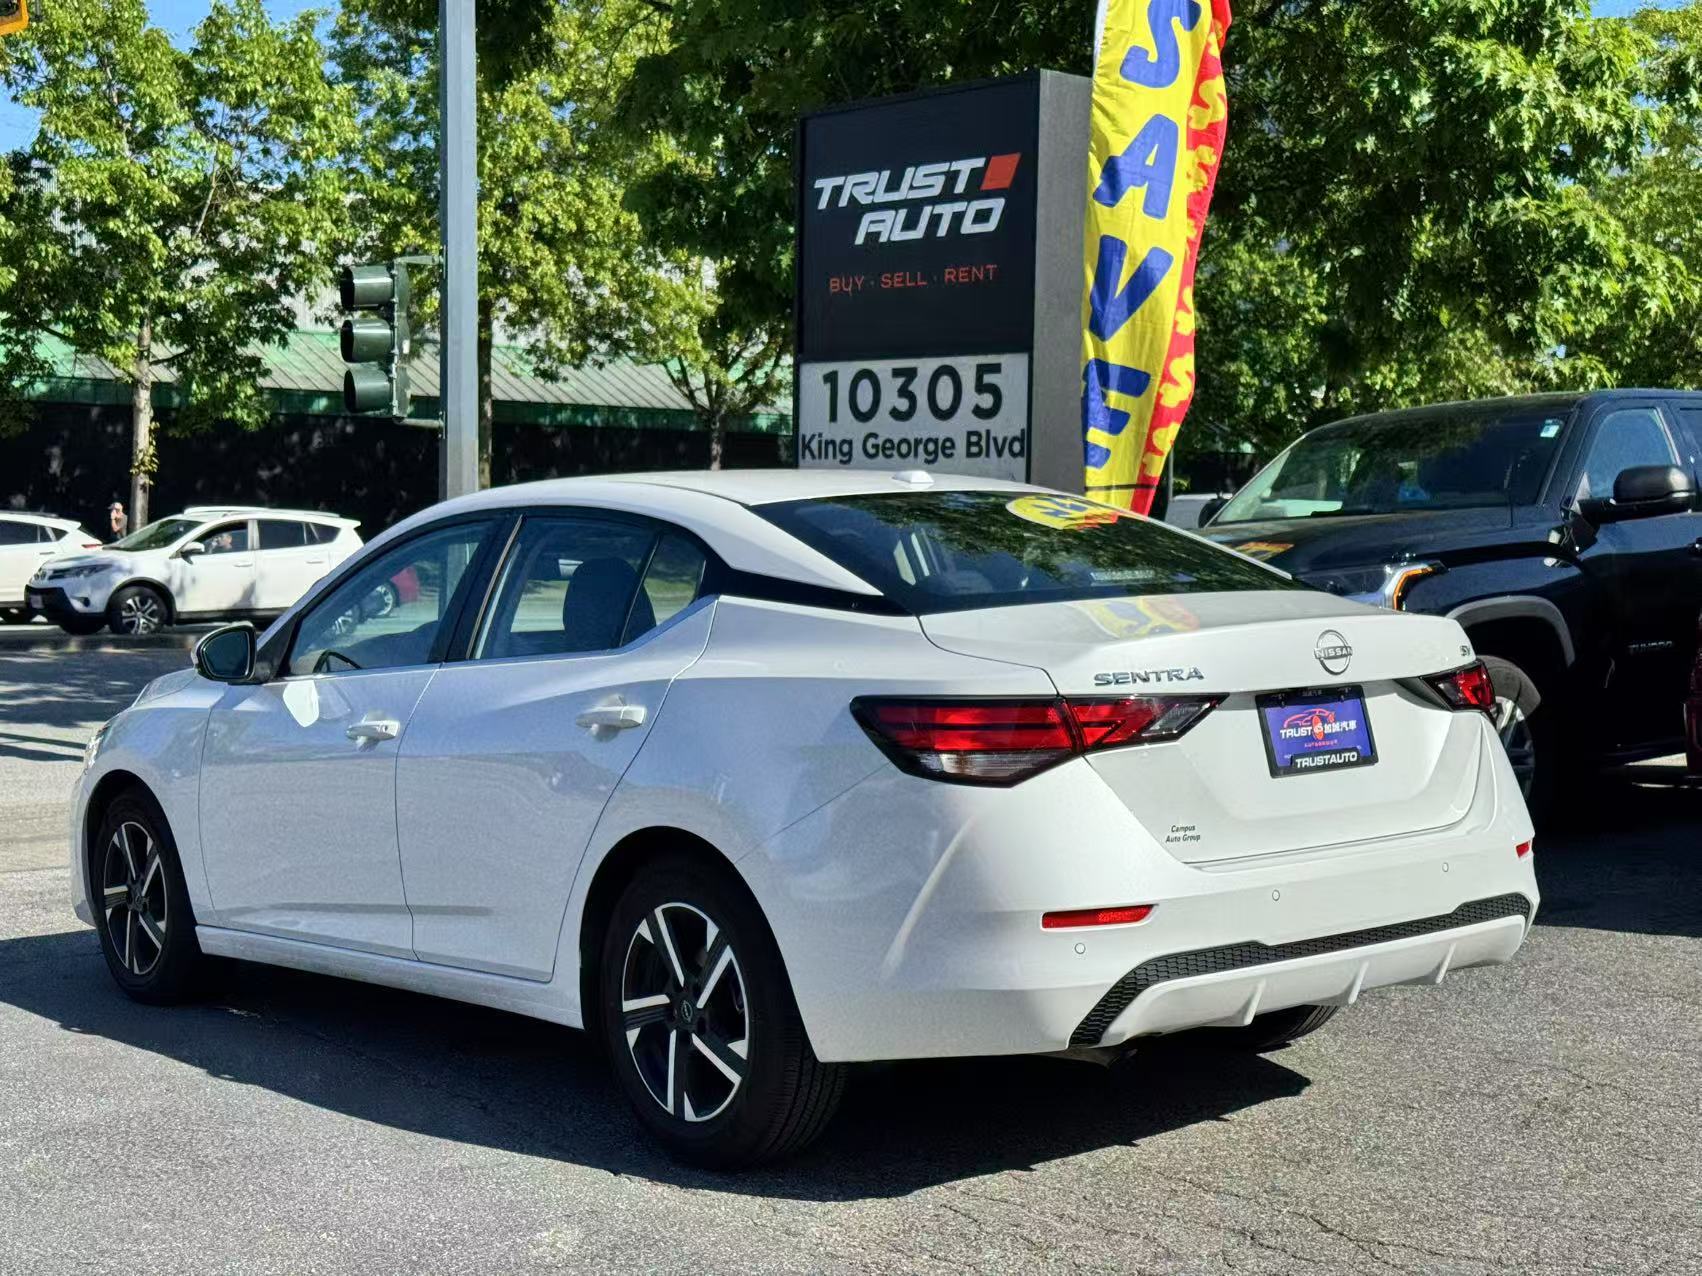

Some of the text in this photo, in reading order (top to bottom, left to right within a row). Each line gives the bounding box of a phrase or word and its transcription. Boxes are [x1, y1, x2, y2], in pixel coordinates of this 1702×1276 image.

[813, 157, 986, 210] TRUST
[854, 197, 1006, 246] AUTO
[829, 264, 998, 295] BUY SELL RENT
[821, 362, 1003, 424] 10305
[801, 428, 1027, 466] King George Blvd
[1315, 646, 1353, 658] NISSAN
[1093, 666, 1205, 687] SENTRA
[1280, 726, 1313, 740] TRUST
[1295, 751, 1358, 769] TRUSTAUTO
[1165, 833, 1201, 844] Auto Group
[1170, 824, 1196, 834] Campus
